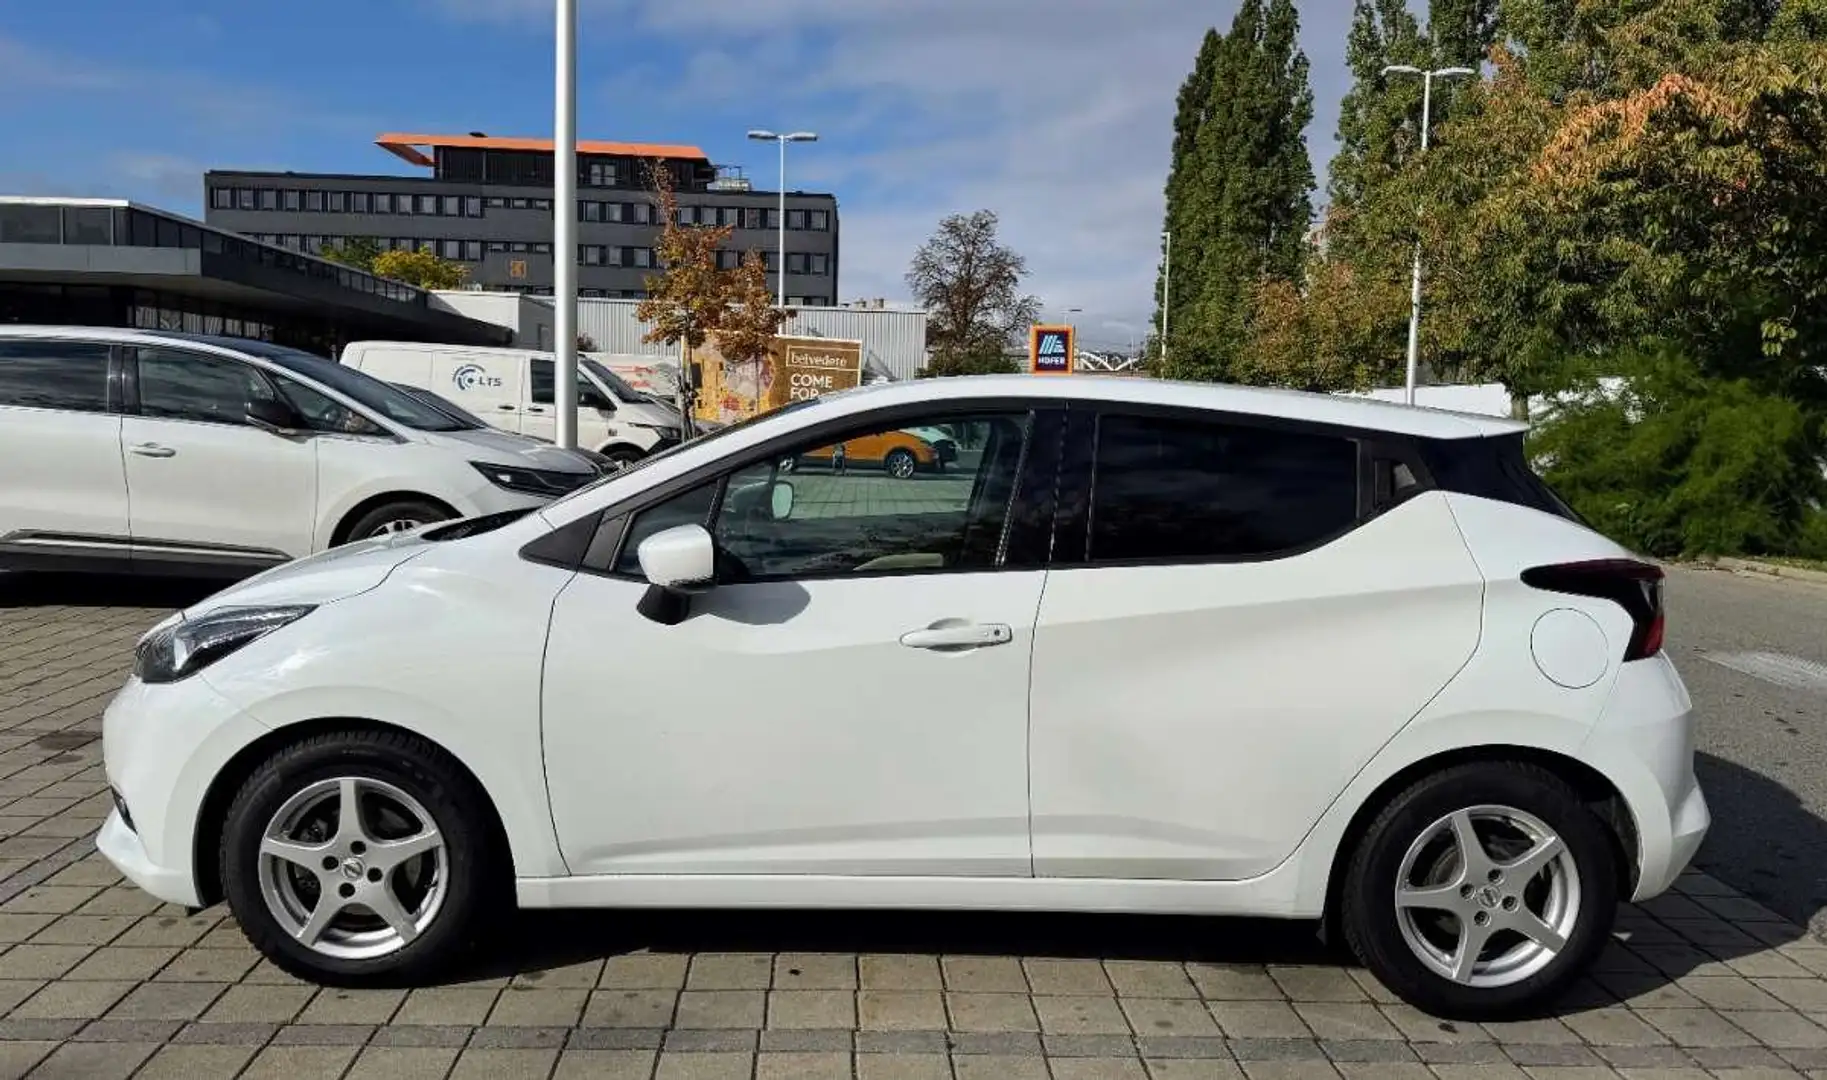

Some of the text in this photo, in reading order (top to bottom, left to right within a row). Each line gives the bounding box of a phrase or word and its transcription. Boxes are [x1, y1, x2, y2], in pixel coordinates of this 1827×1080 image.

[1038, 356, 1065, 364] HOFER
[479, 376, 502, 387] LTS
[790, 373, 834, 388] COME
